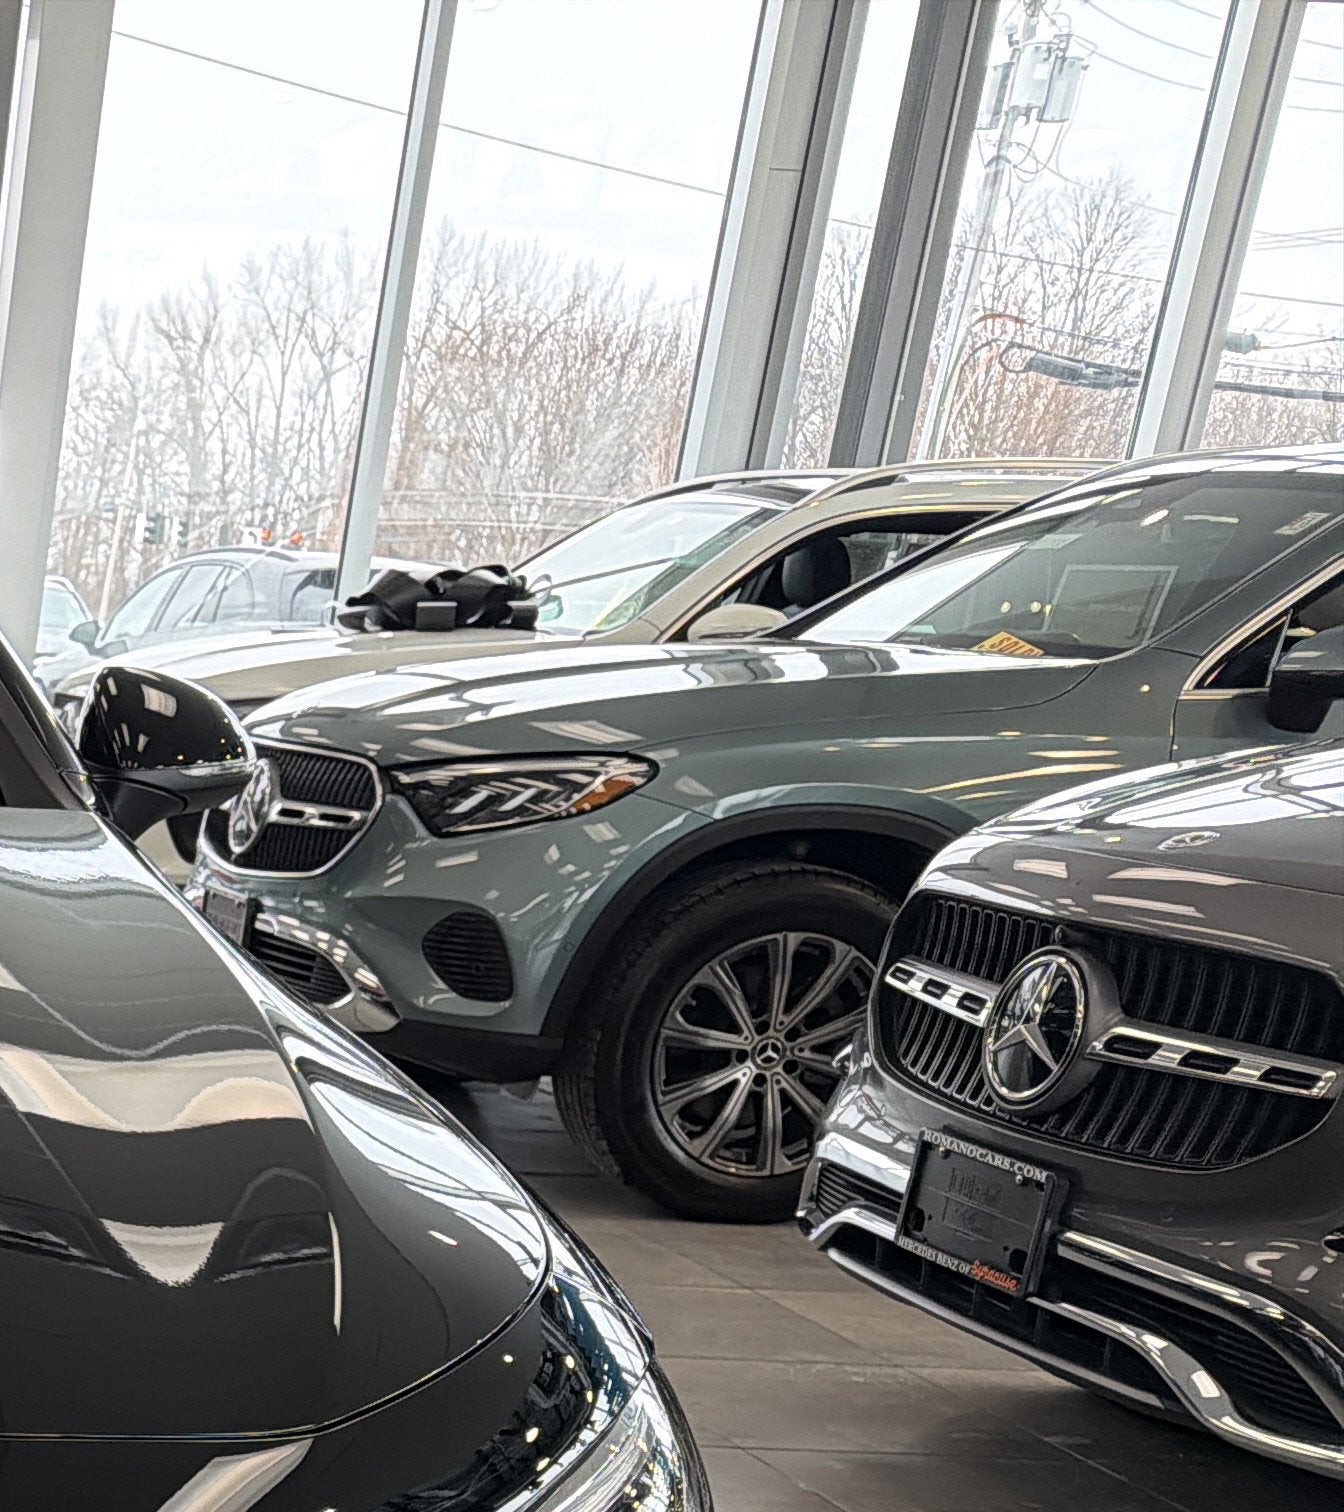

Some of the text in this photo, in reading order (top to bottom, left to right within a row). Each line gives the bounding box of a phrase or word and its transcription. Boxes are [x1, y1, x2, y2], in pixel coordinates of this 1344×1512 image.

[922, 1130, 1048, 1183] ROMANOCARS.COM
[897, 1238, 1019, 1291] MERCEDES BENZ OF Syracuse
